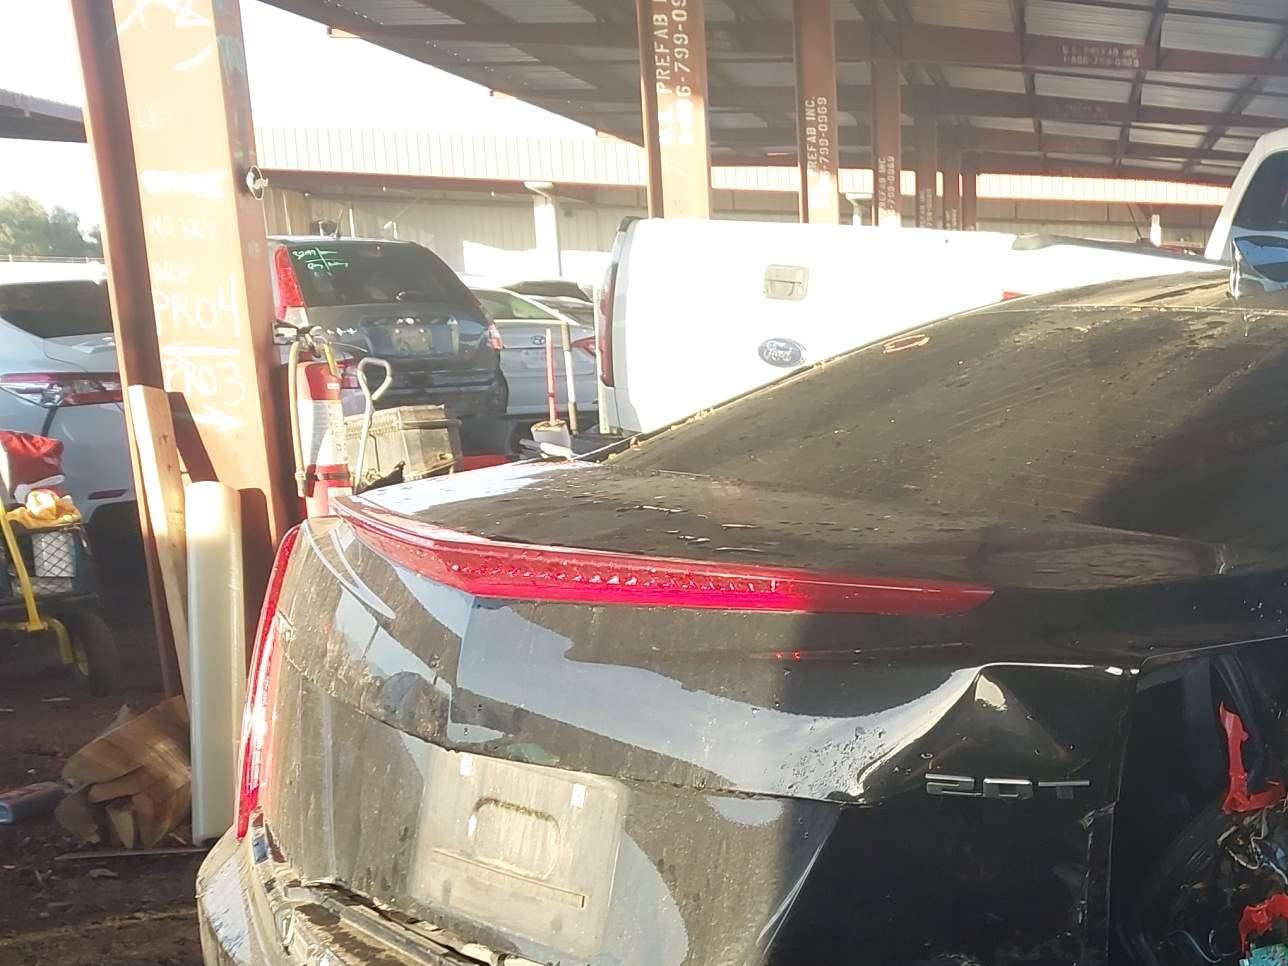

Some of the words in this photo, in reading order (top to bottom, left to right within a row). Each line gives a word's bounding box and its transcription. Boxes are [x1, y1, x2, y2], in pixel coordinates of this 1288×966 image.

[652, 13, 672, 95] PREFAB
[151, 272, 241, 340] PRO4
[763, 340, 793, 362] Ford
